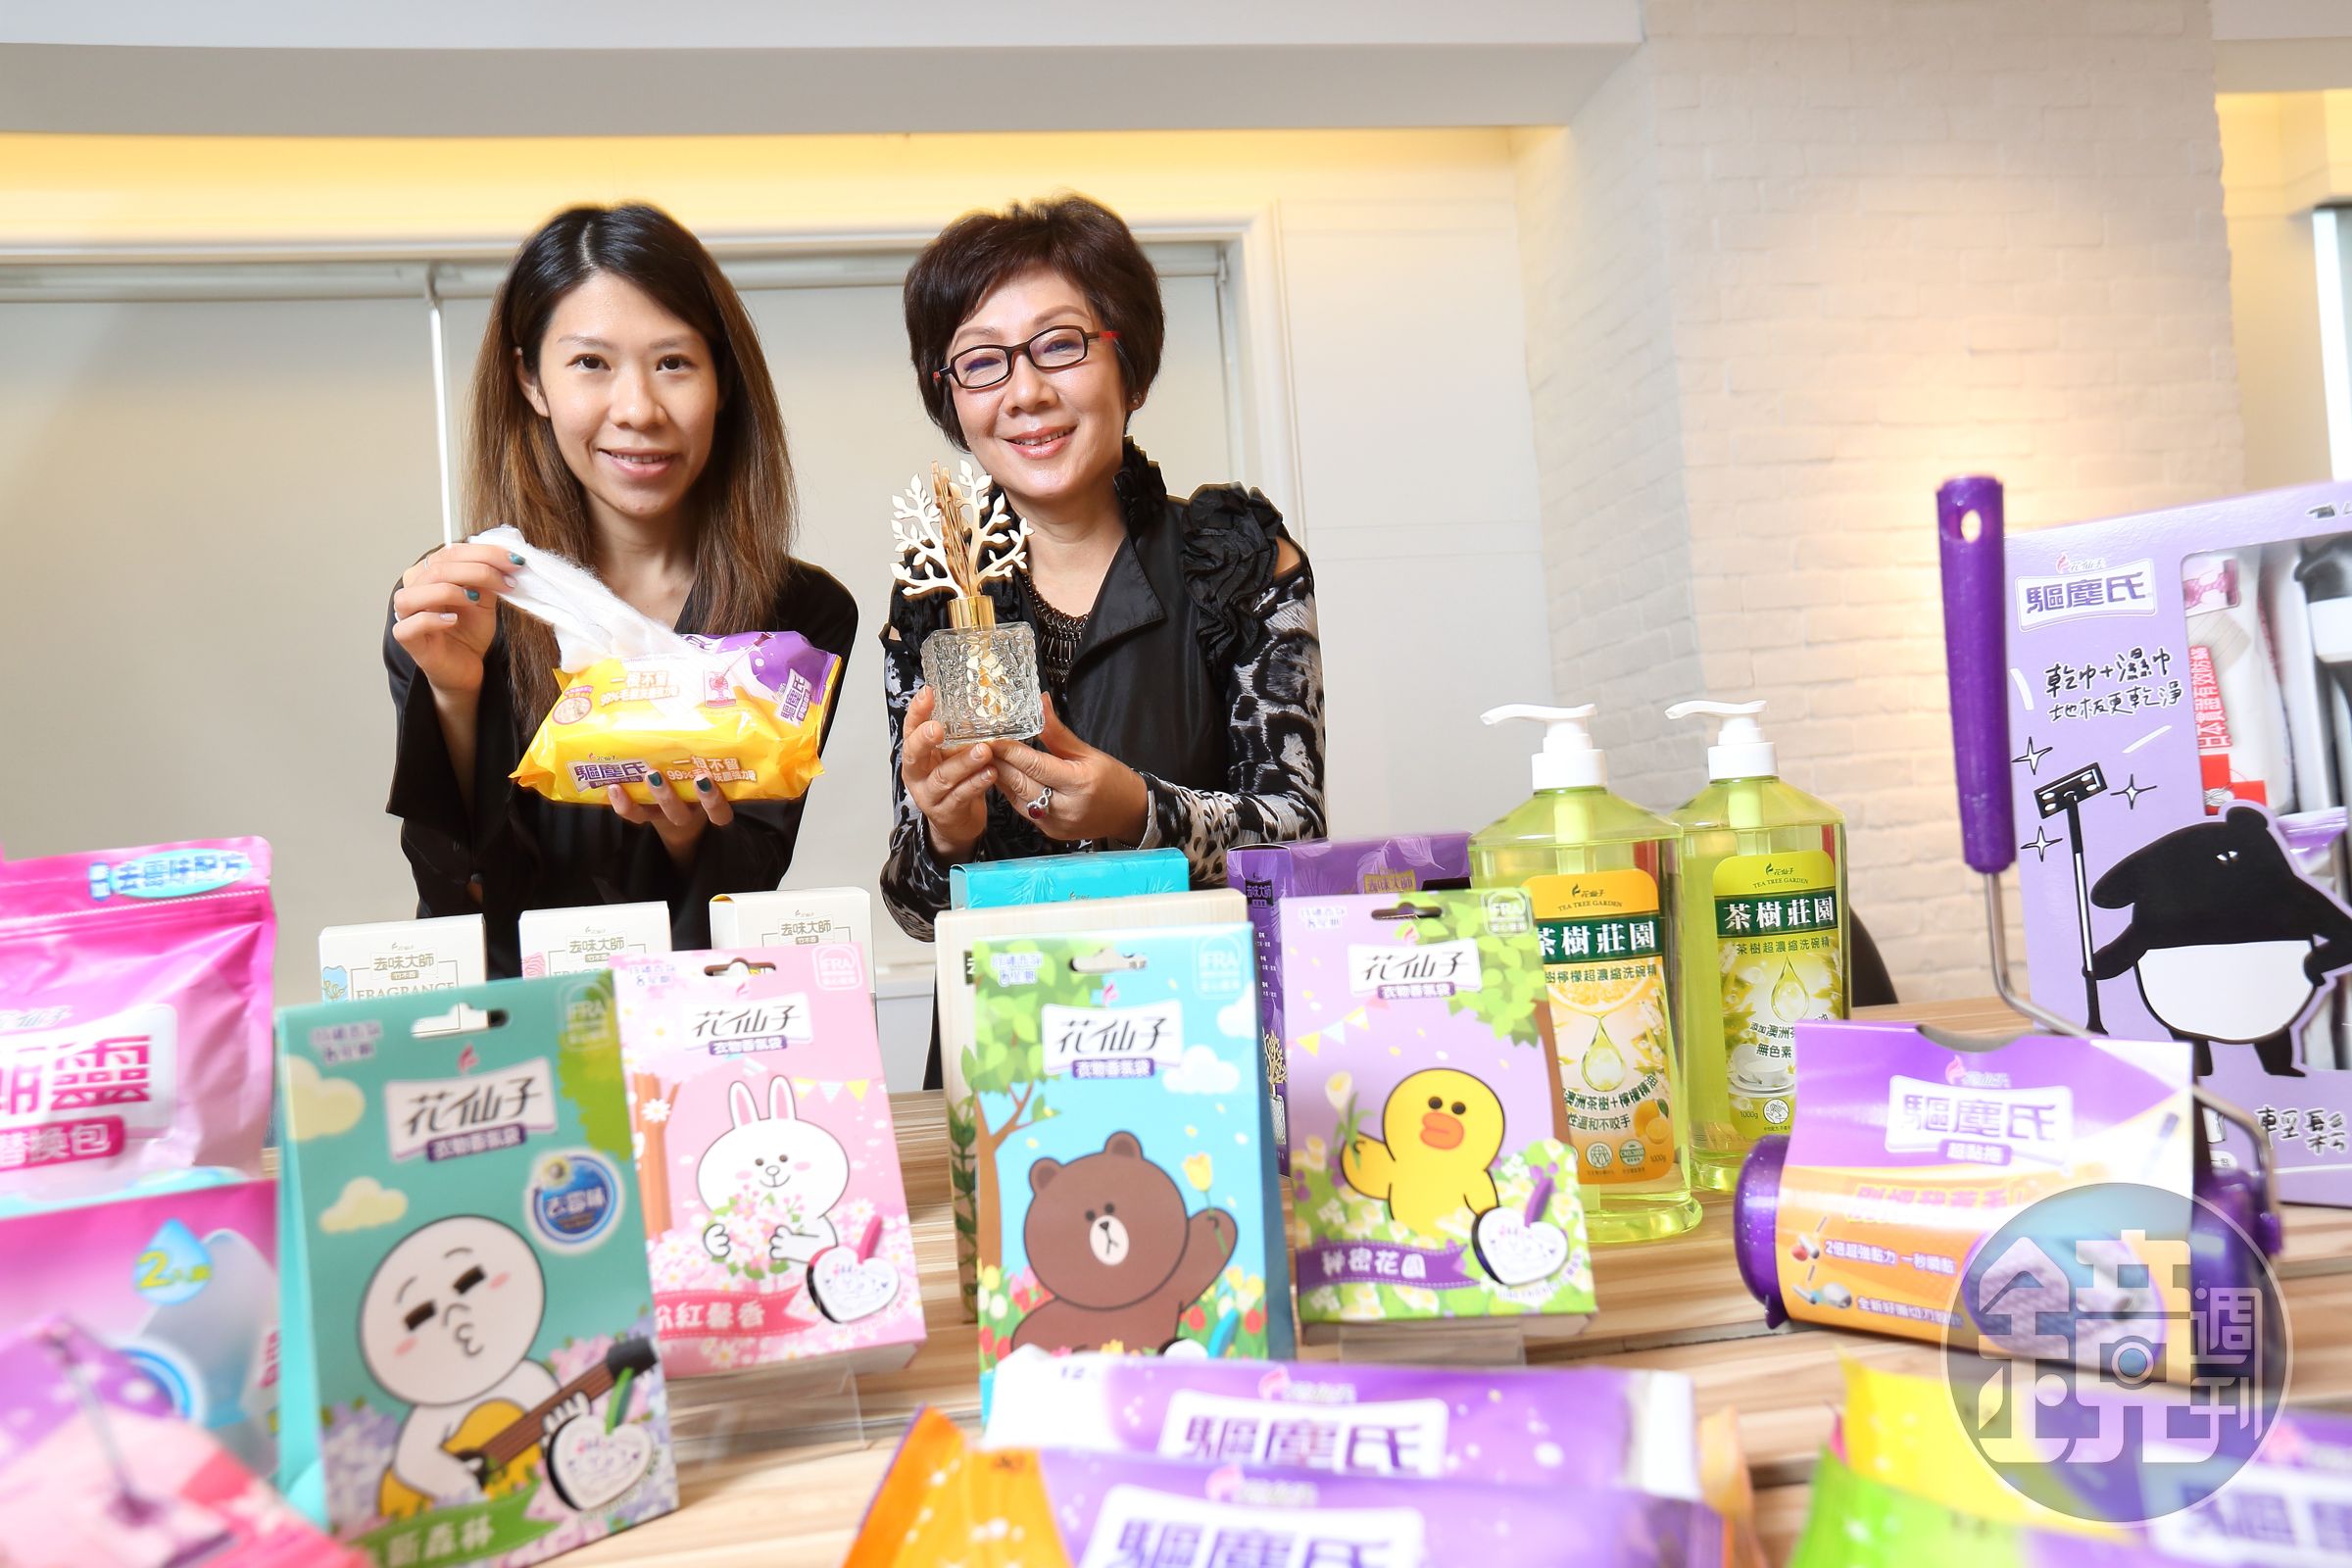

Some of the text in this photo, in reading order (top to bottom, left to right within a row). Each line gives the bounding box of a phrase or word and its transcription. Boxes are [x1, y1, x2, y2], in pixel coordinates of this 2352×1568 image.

[2026, 571, 2146, 614] 驅塵氏
[780, 673, 806, 721] 驅塵氏
[2049, 680, 2182, 722] 地板更乾淨
[574, 760, 647, 782] 驅塵氏
[1558, 904, 1572, 912] TEA
[1592, 900, 1624, 908] GARDEN
[1723, 896, 1835, 930] 茶樹莊園
[780, 919, 832, 936] 去味大師
[1537, 920, 1656, 956] 茶樹莊園
[373, 953, 435, 971] 去味大師
[568, 937, 625, 954] 去味大師
[1363, 951, 1469, 981] 花仙子
[692, 1004, 801, 1038] 花仙子
[1056, 1016, 1172, 1054] 花仙子
[1756, 1042, 1792, 1058] 無色素
[406, 1076, 542, 1136] 花仙子
[1740, 1110, 1759, 1119] 1000g
[1901, 1093, 2056, 1142] 驅塵氏
[0, 1123, 112, 1165] 替換包
[1182, 1414, 1422, 1471] 驅塵氏
